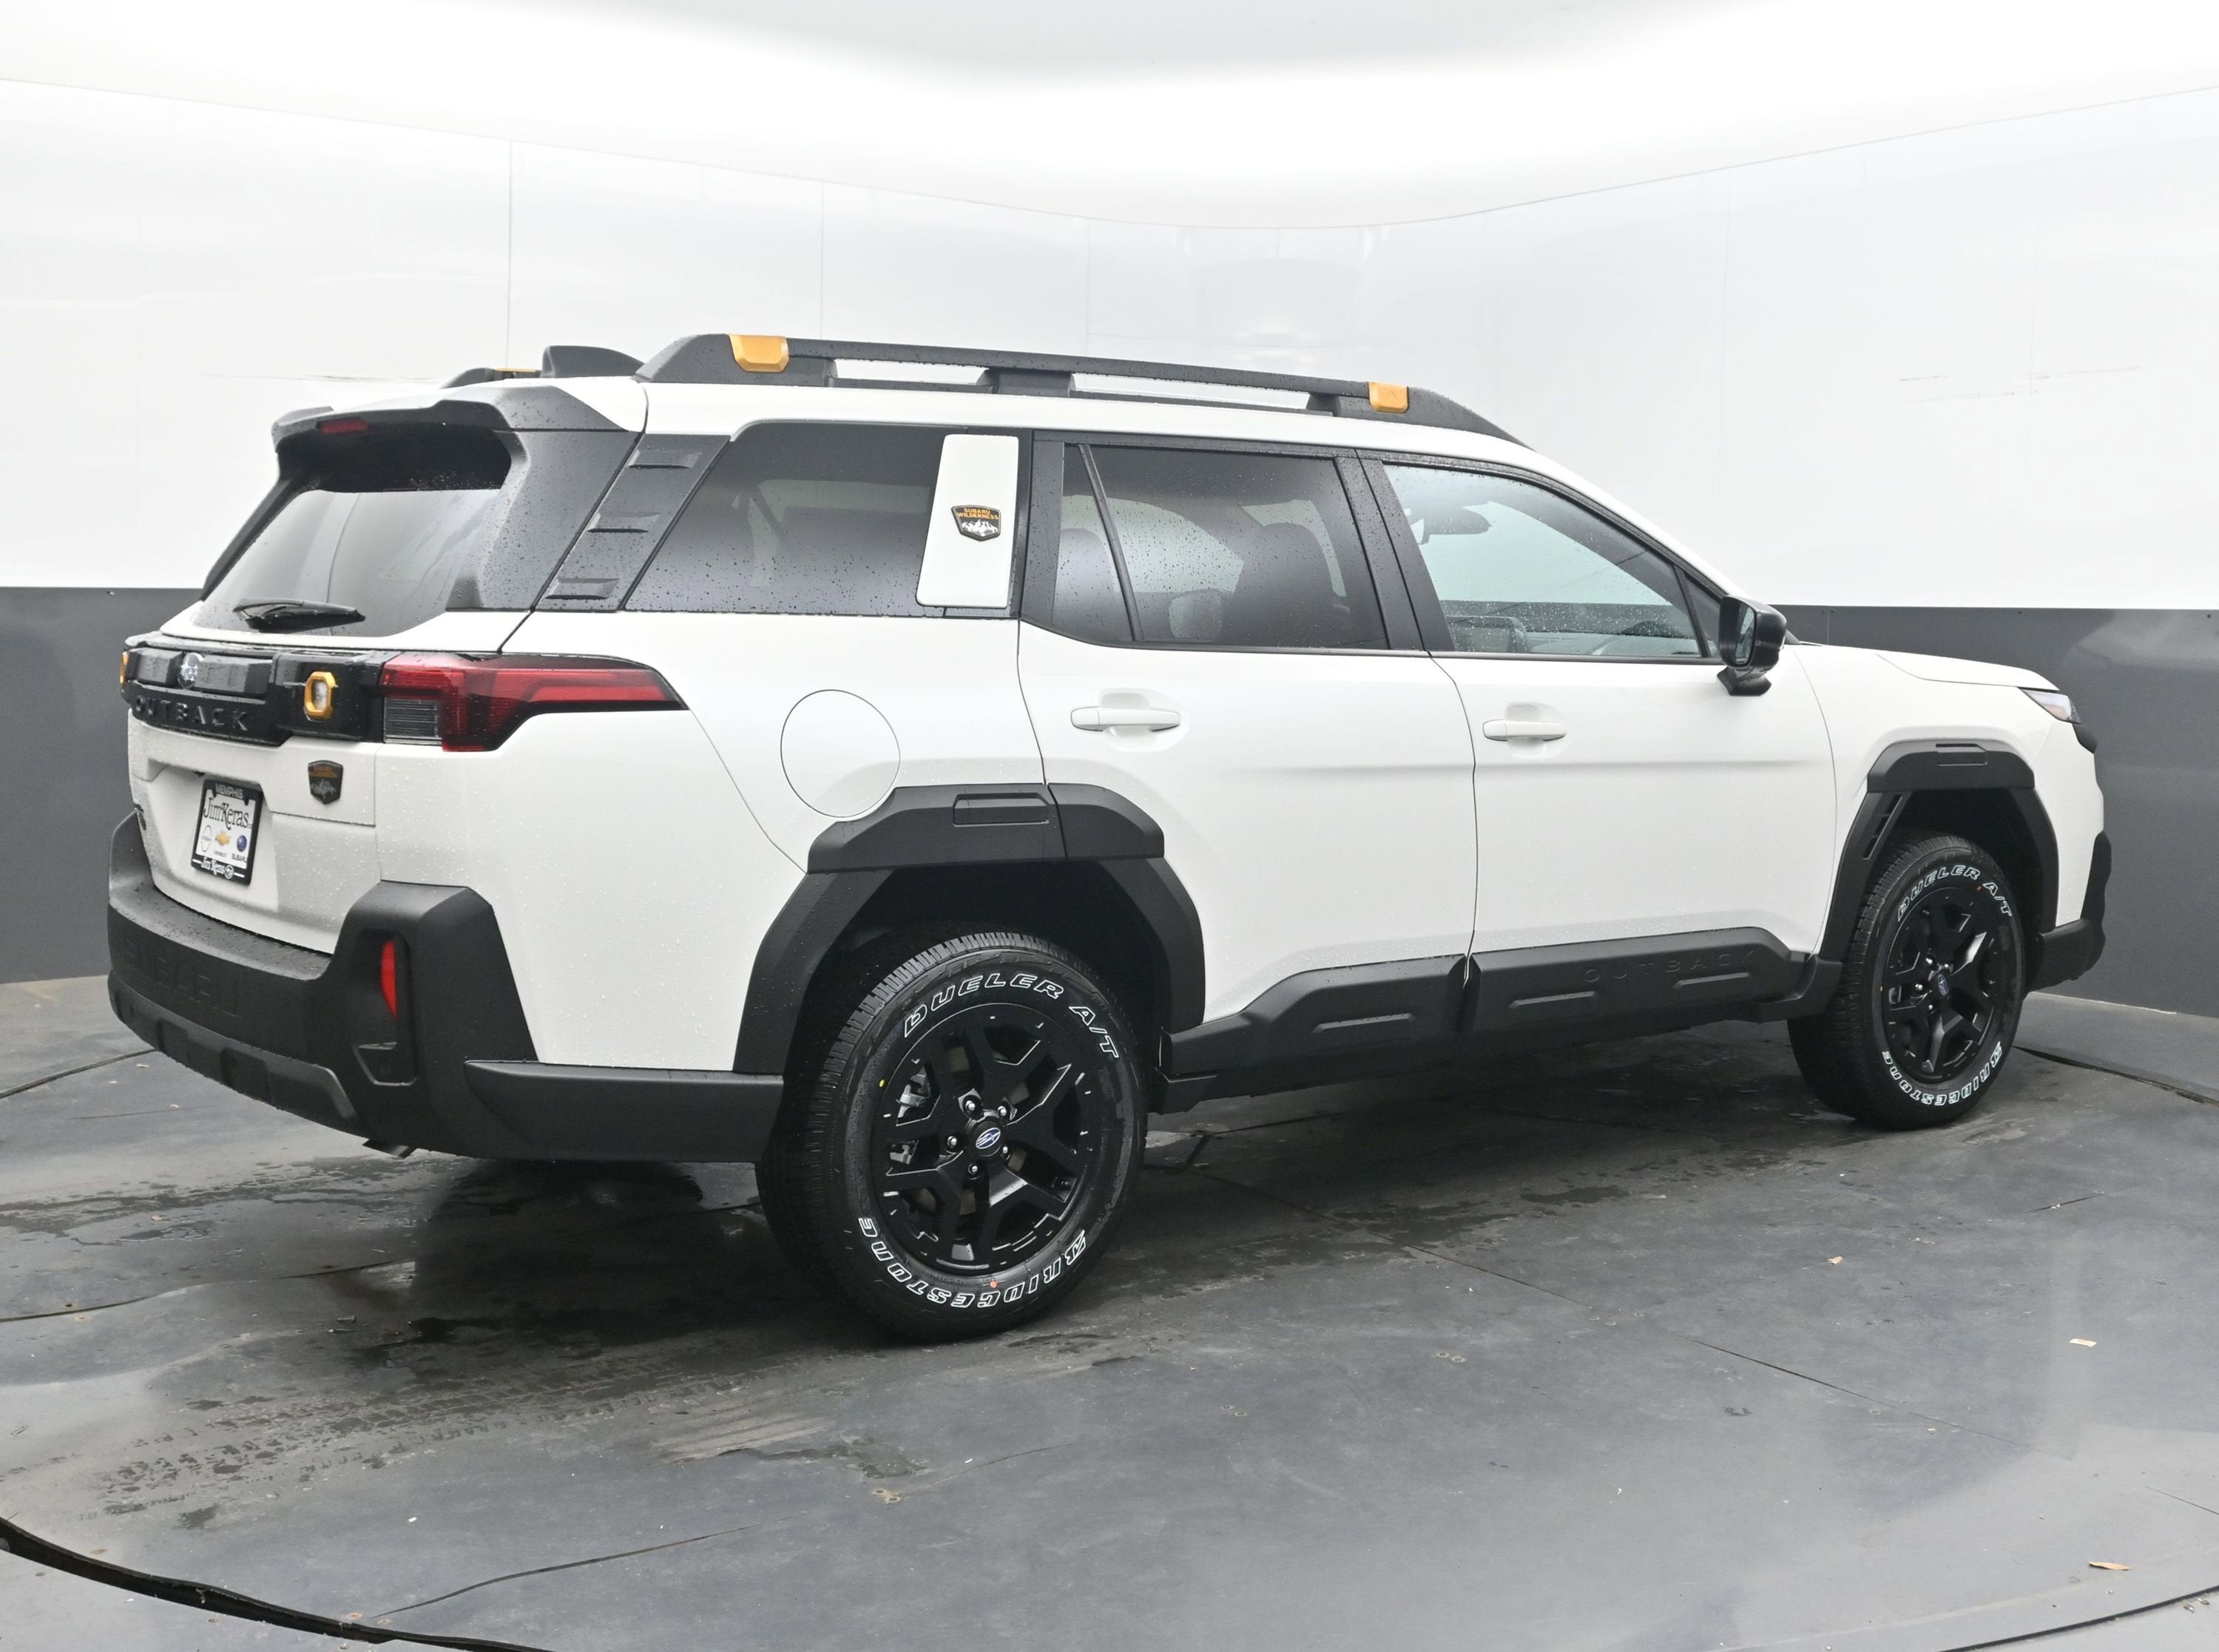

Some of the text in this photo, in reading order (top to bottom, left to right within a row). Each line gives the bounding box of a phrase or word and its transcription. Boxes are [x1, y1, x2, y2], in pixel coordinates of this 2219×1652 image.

[956, 512, 999, 520] WILDERNESS
[135, 694, 248, 731] OUTBACK
[215, 782, 243, 799] MEMPHIS
[1897, 864, 1981, 922] DUELER
[904, 972, 1064, 1038] DUELER
[1881, 1040, 2003, 1106] BRIDGESTONE
[858, 1217, 1086, 1308] BRIDGESTONE
